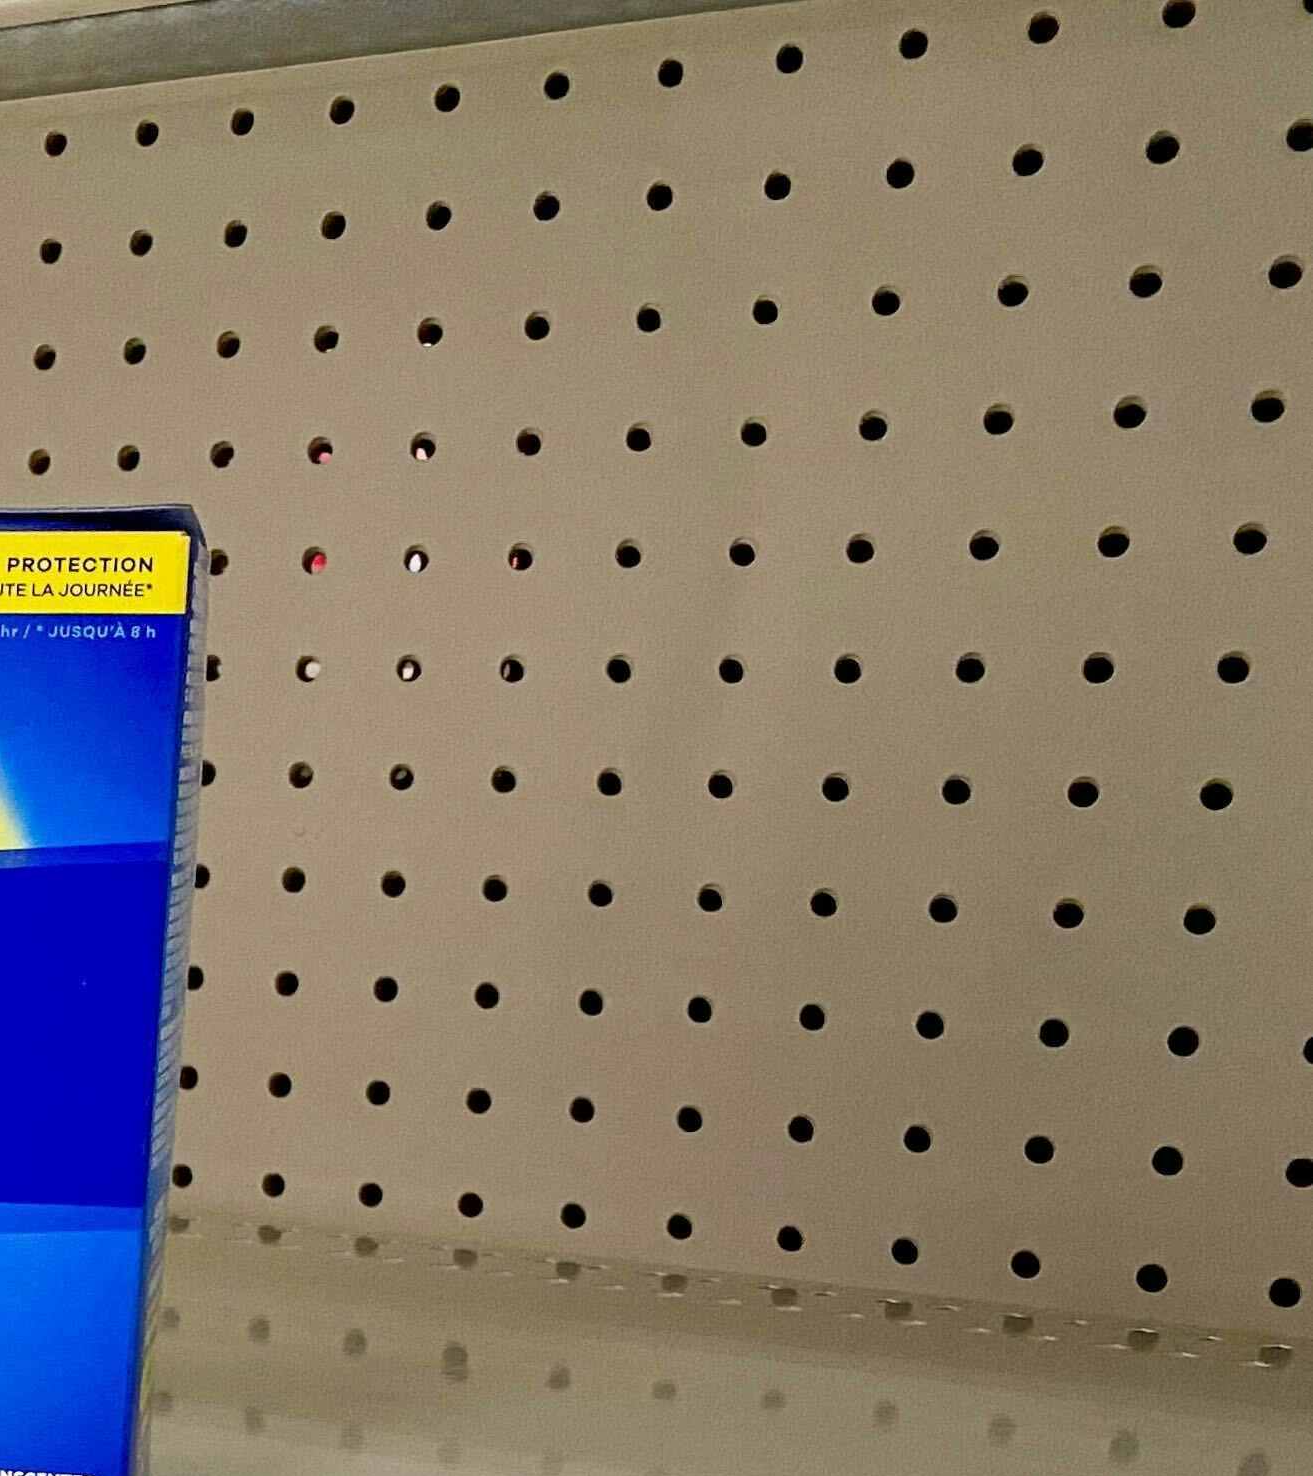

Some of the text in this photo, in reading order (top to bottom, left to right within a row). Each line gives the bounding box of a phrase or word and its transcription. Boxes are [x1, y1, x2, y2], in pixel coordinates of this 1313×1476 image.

[7, 557, 154, 573] PROTECTION
[31, 582, 55, 597] LA
[0, 624, 19, 638] hr
[47, 621, 126, 639] JUSQU'À
[130, 624, 141, 638] 8
[146, 624, 157, 638] h
